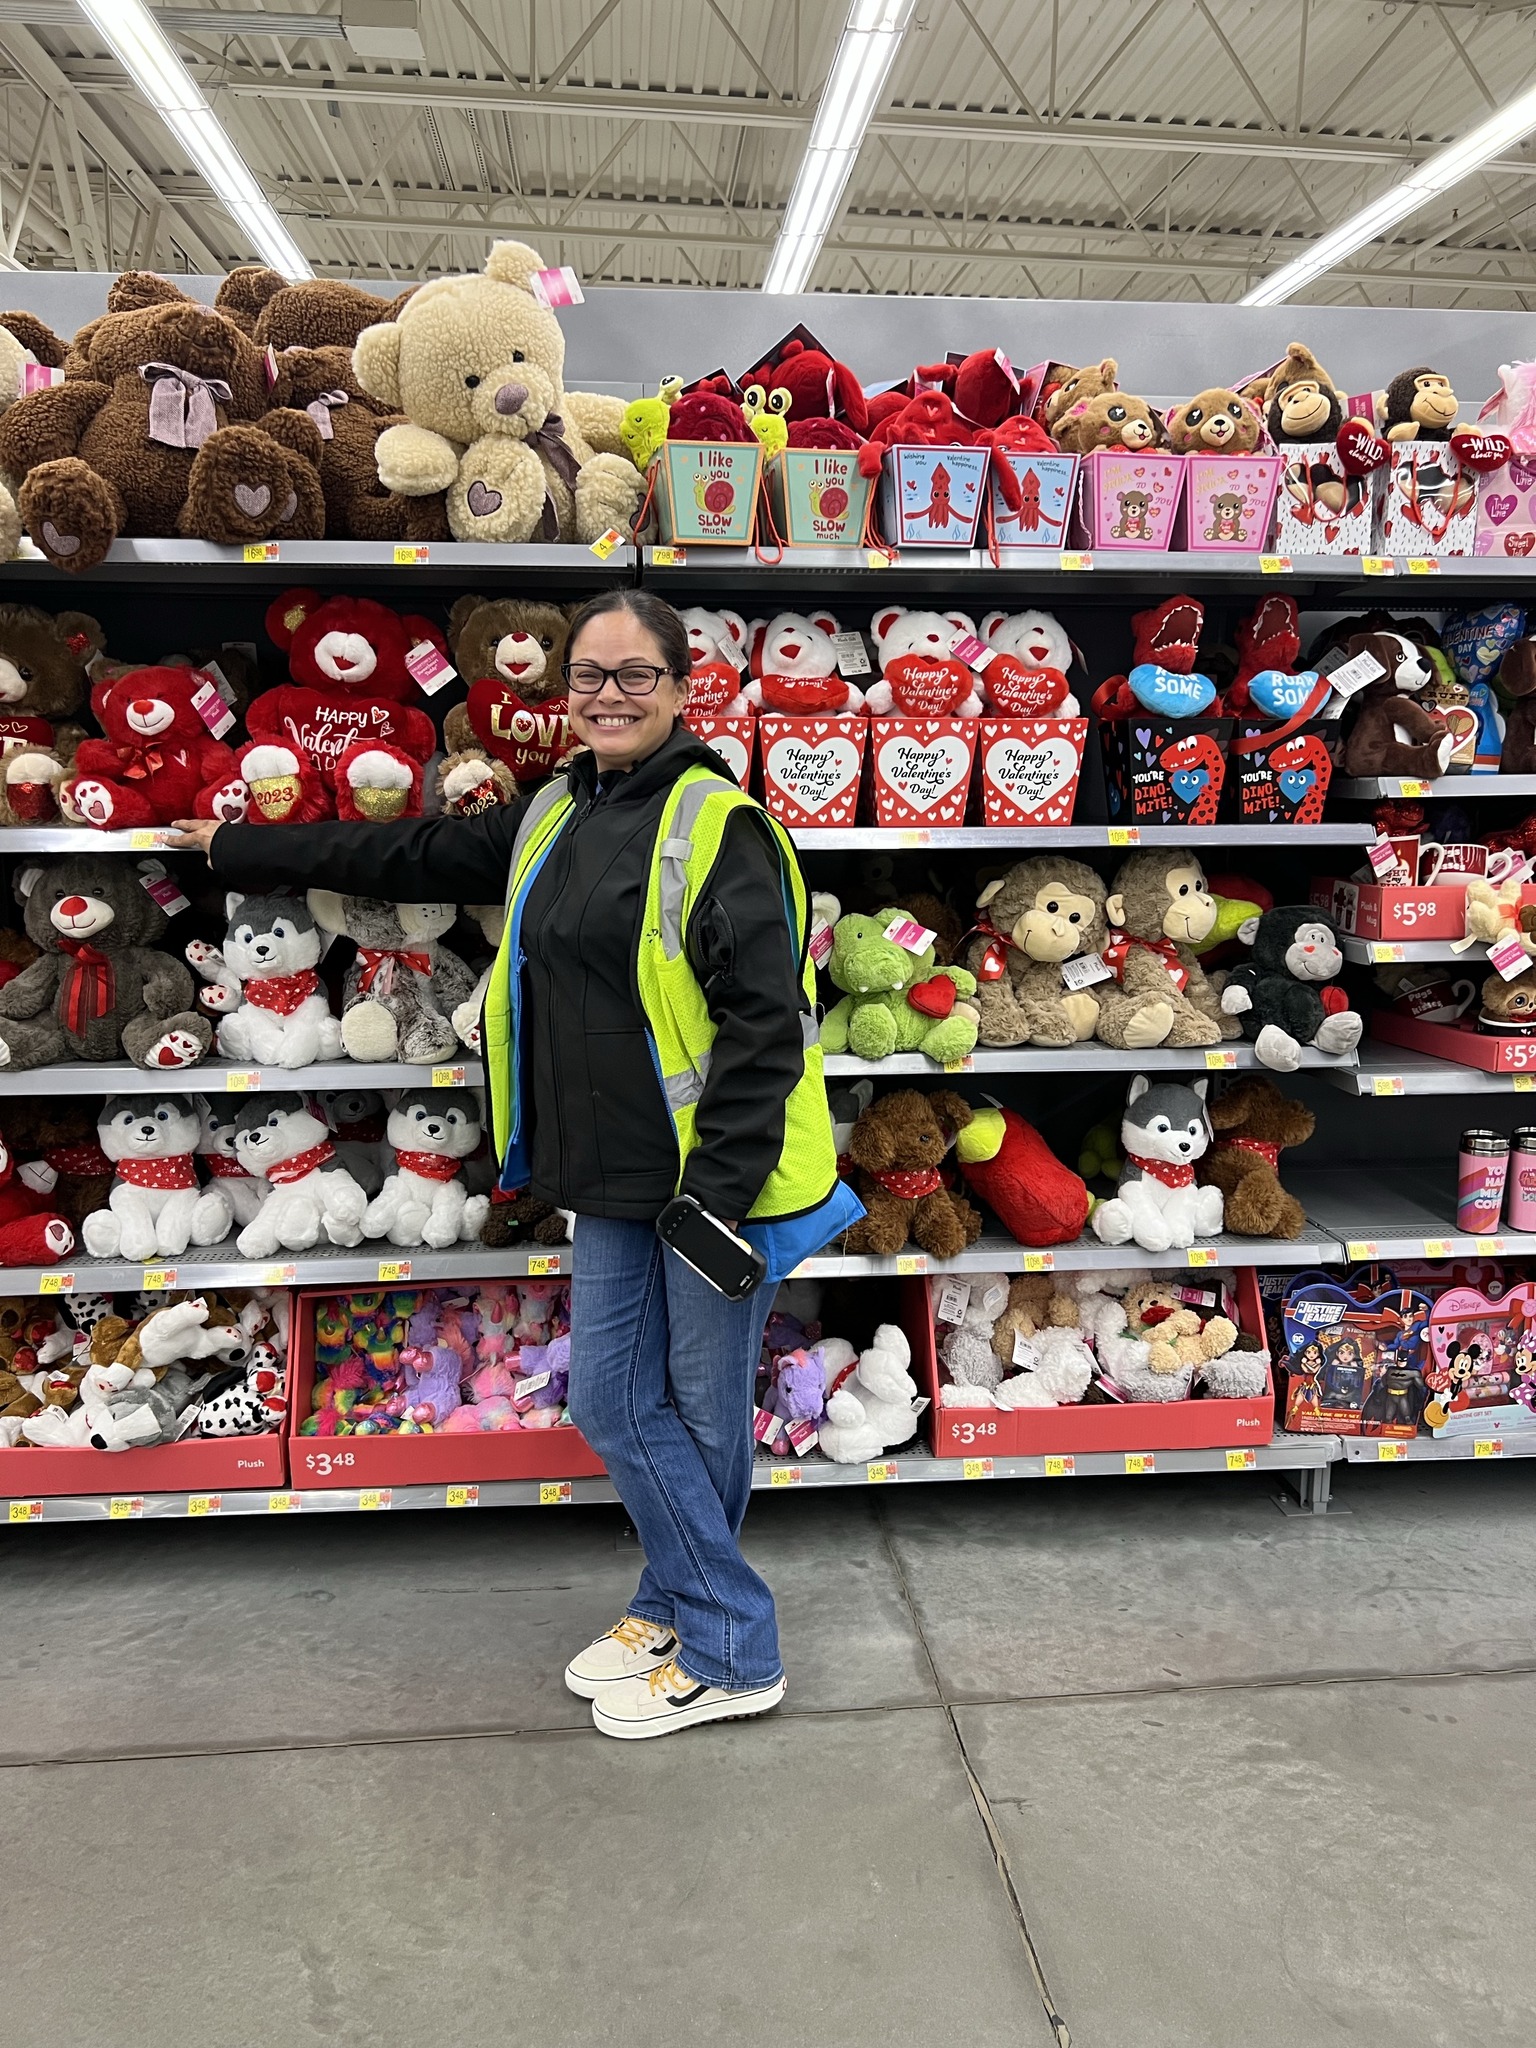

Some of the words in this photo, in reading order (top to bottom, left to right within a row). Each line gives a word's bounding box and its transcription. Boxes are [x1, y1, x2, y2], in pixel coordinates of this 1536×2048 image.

[1355, 432, 1382, 461] WILD
[1471, 438, 1505, 452] WILD
[698, 451, 703, 468] I
[708, 450, 734, 468] like
[904, 453, 925, 461] Wishing
[1349, 448, 1366, 462] about
[1471, 450, 1492, 458] about
[814, 459, 819, 474] I
[824, 458, 848, 475] like
[710, 470, 730, 482] you
[826, 477, 844, 488] you
[1154, 496, 1172, 506] YOU
[1248, 498, 1268, 508] YOU
[1494, 498, 1510, 510] True
[698, 514, 732, 527] SLOW
[812, 520, 846, 532] SLOW
[702, 526, 726, 535] much
[816, 532, 840, 540] much
[1508, 536, 1529, 548] Sweet
[1458, 643, 1473, 655] DAY
[903, 668, 950, 685] Happy
[1002, 666, 1046, 688] Happy
[899, 680, 958, 700] Valentine's
[993, 681, 1053, 704] Valentine's
[1154, 677, 1203, 700] SOME
[501, 691, 512, 704] I
[918, 700, 945, 716] Day!
[1010, 702, 1038, 717] Day!
[515, 748, 551, 765] you
[786, 748, 834, 768] Happy
[898, 748, 946, 768] Happy
[1004, 749, 1053, 768] Happy
[780, 762, 842, 786] Valentine's
[890, 760, 952, 785] Valentine's
[998, 762, 1060, 786] Valentine's
[1132, 770, 1165, 784] YOU'RE
[1240, 770, 1273, 784] YOU'RE
[257, 786, 295, 805] 2023
[799, 784, 828, 802] Day!
[909, 784, 938, 800] Day!
[1016, 784, 1045, 801] Day!
[1134, 782, 1172, 800] DINO-
[1242, 782, 1278, 800] DINO-
[462, 792, 498, 816] 2023
[1136, 796, 1174, 814] MITE!
[1244, 796, 1280, 814] MITE!
[1366, 915, 1377, 928] Mug
[1408, 988, 1432, 1002] Pugs
[1298, 1302, 1342, 1314] JUSTICE
[1446, 1299, 1481, 1312] Disney
[1304, 1312, 1340, 1325] LEAGUE
[1292, 1334, 1304, 1343] DC
[1236, 1418, 1260, 1428] Plush
[238, 1460, 264, 1468] Plush
